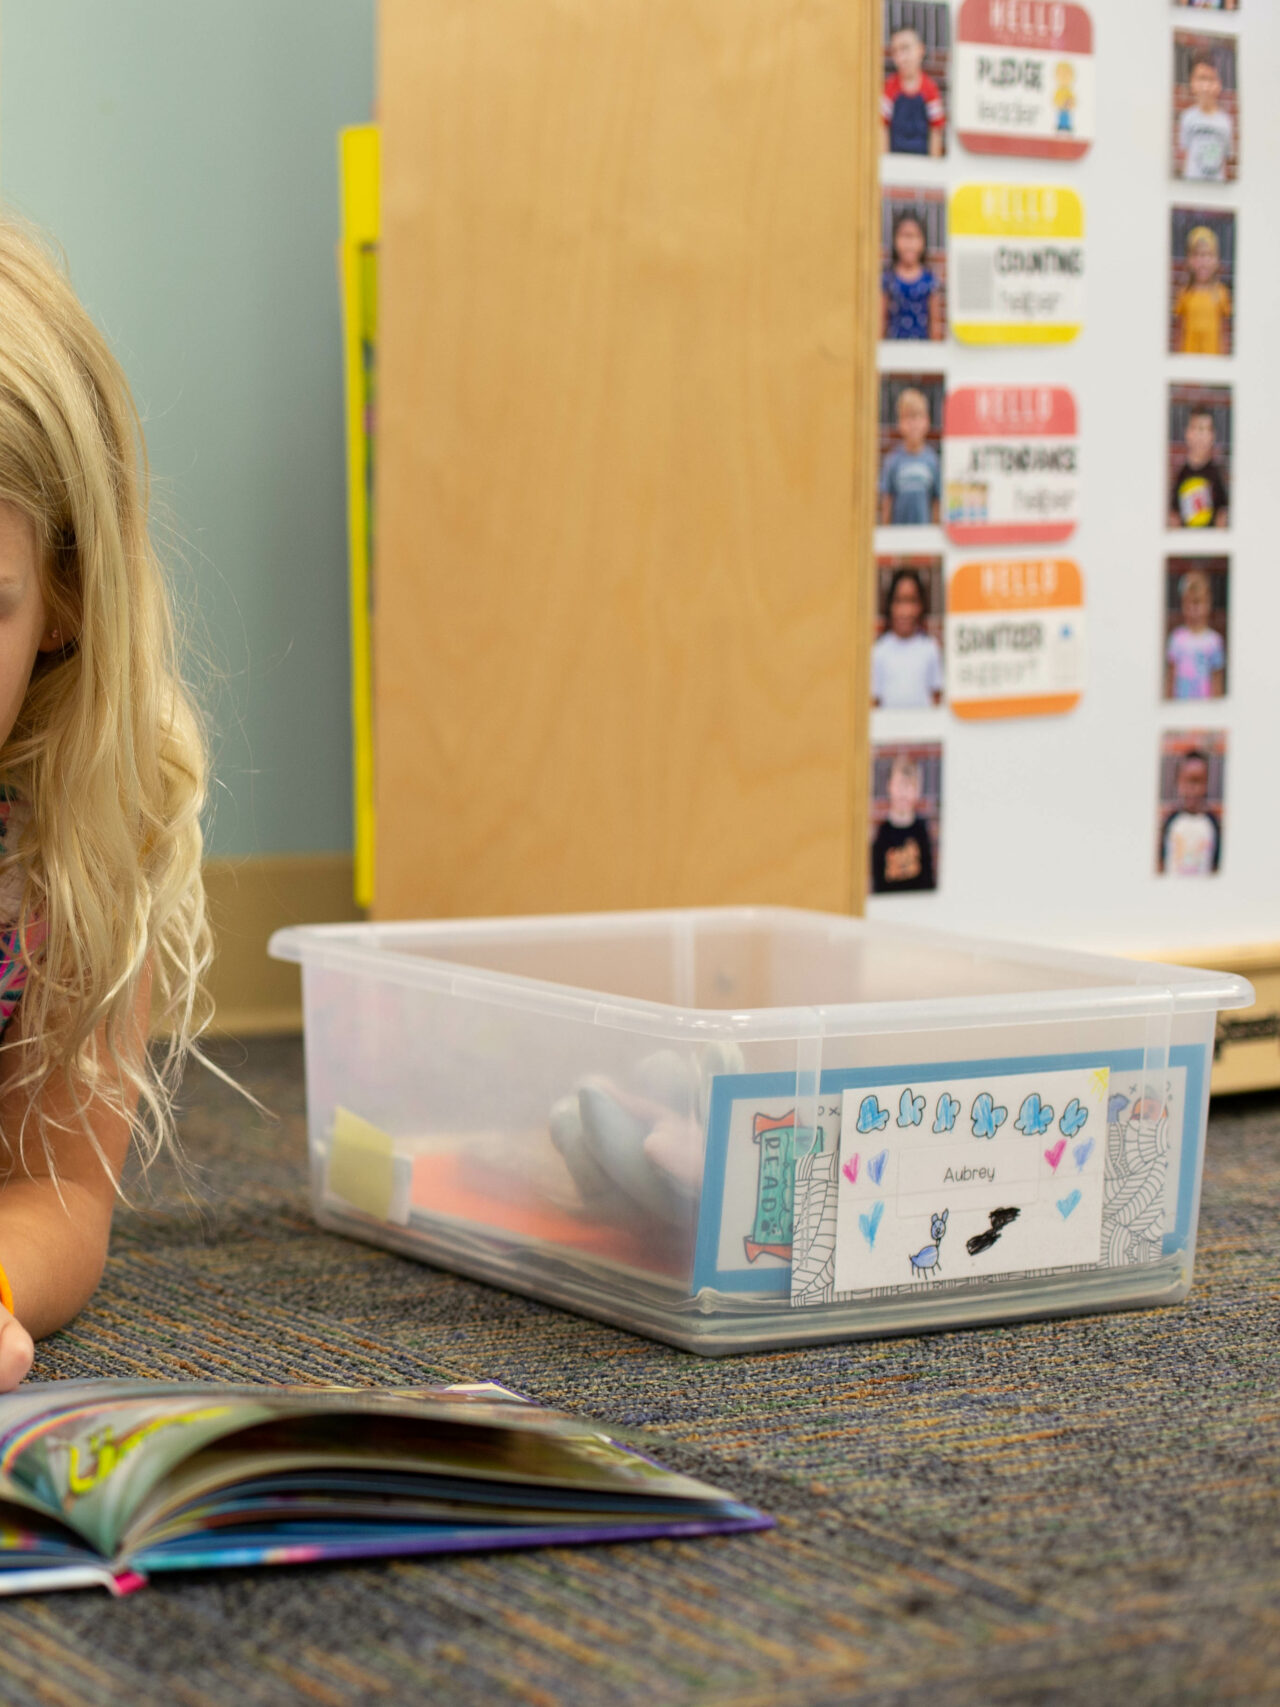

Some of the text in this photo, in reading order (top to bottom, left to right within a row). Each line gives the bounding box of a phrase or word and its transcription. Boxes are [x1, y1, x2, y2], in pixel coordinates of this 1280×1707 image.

[989, 0, 1066, 37] HELLO
[976, 56, 1043, 92] PLEDGE
[982, 188, 1058, 222] HELLO
[994, 246, 1083, 278] COUNTING
[976, 389, 1054, 423] HELLO
[970, 445, 1078, 475] ATTENDANCE
[980, 563, 1058, 597] HELLO
[956, 621, 1046, 656] SANITIZER
[761, 1136, 781, 1212] READ
[943, 1165, 995, 1183] Aubrey
